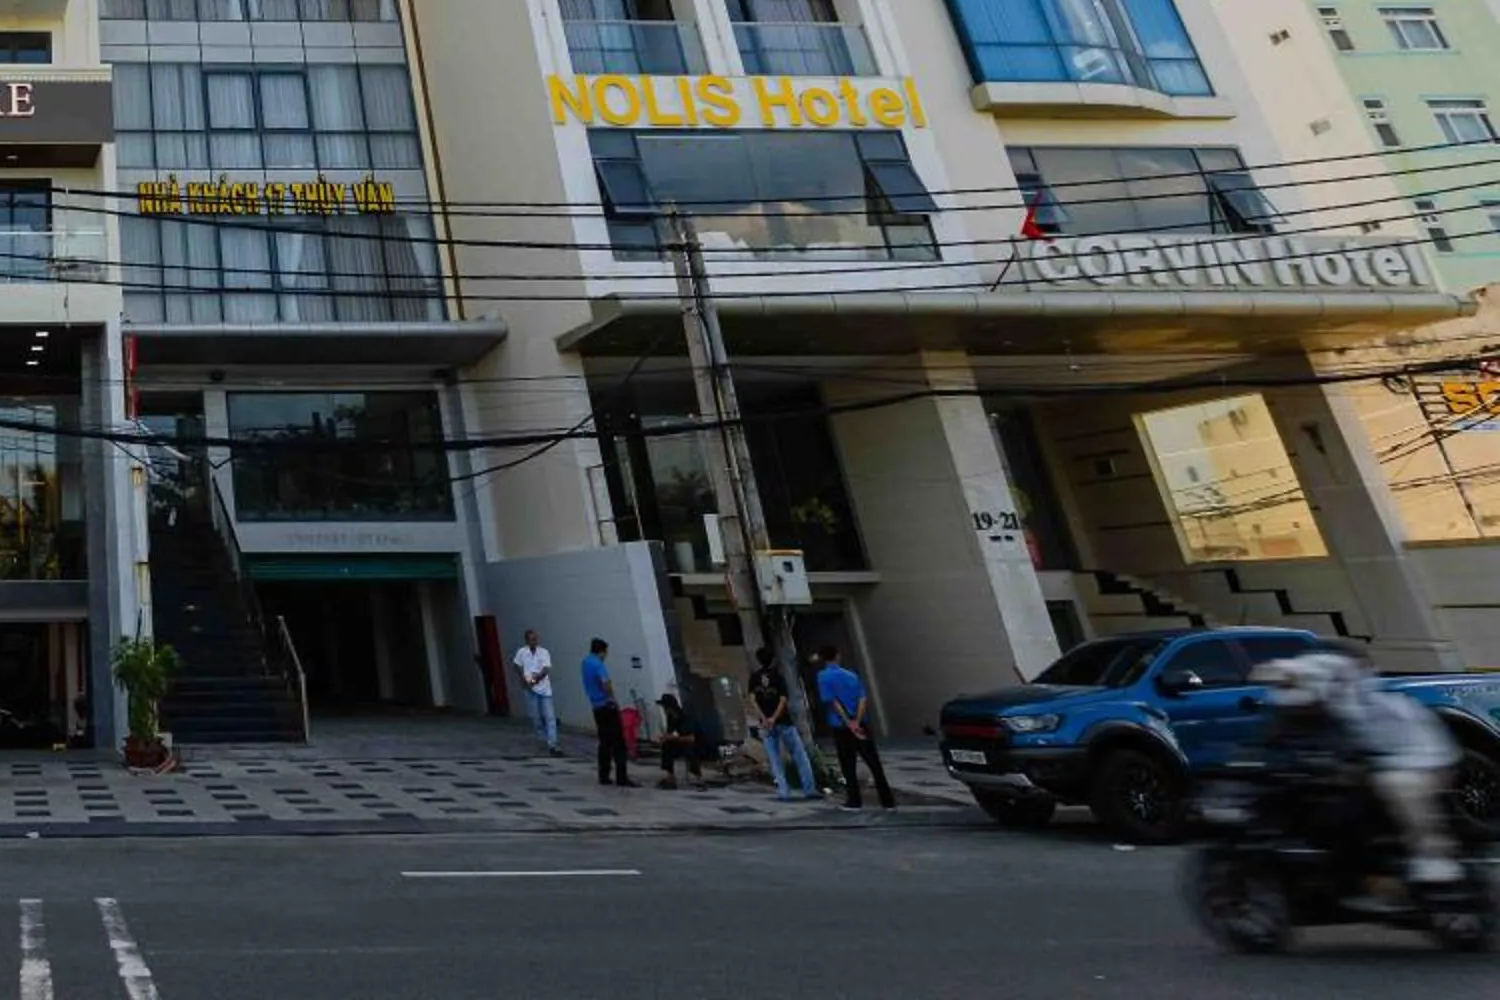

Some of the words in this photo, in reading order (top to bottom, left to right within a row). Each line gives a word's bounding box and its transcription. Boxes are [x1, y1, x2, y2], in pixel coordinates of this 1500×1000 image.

[547, 73, 742, 127] NOLIS
[751, 74, 928, 129] Hotel
[1031, 236, 1269, 287] CORVIN
[1267, 236, 1430, 288] Hotel
[973, 511, 1019, 531] 19-21
